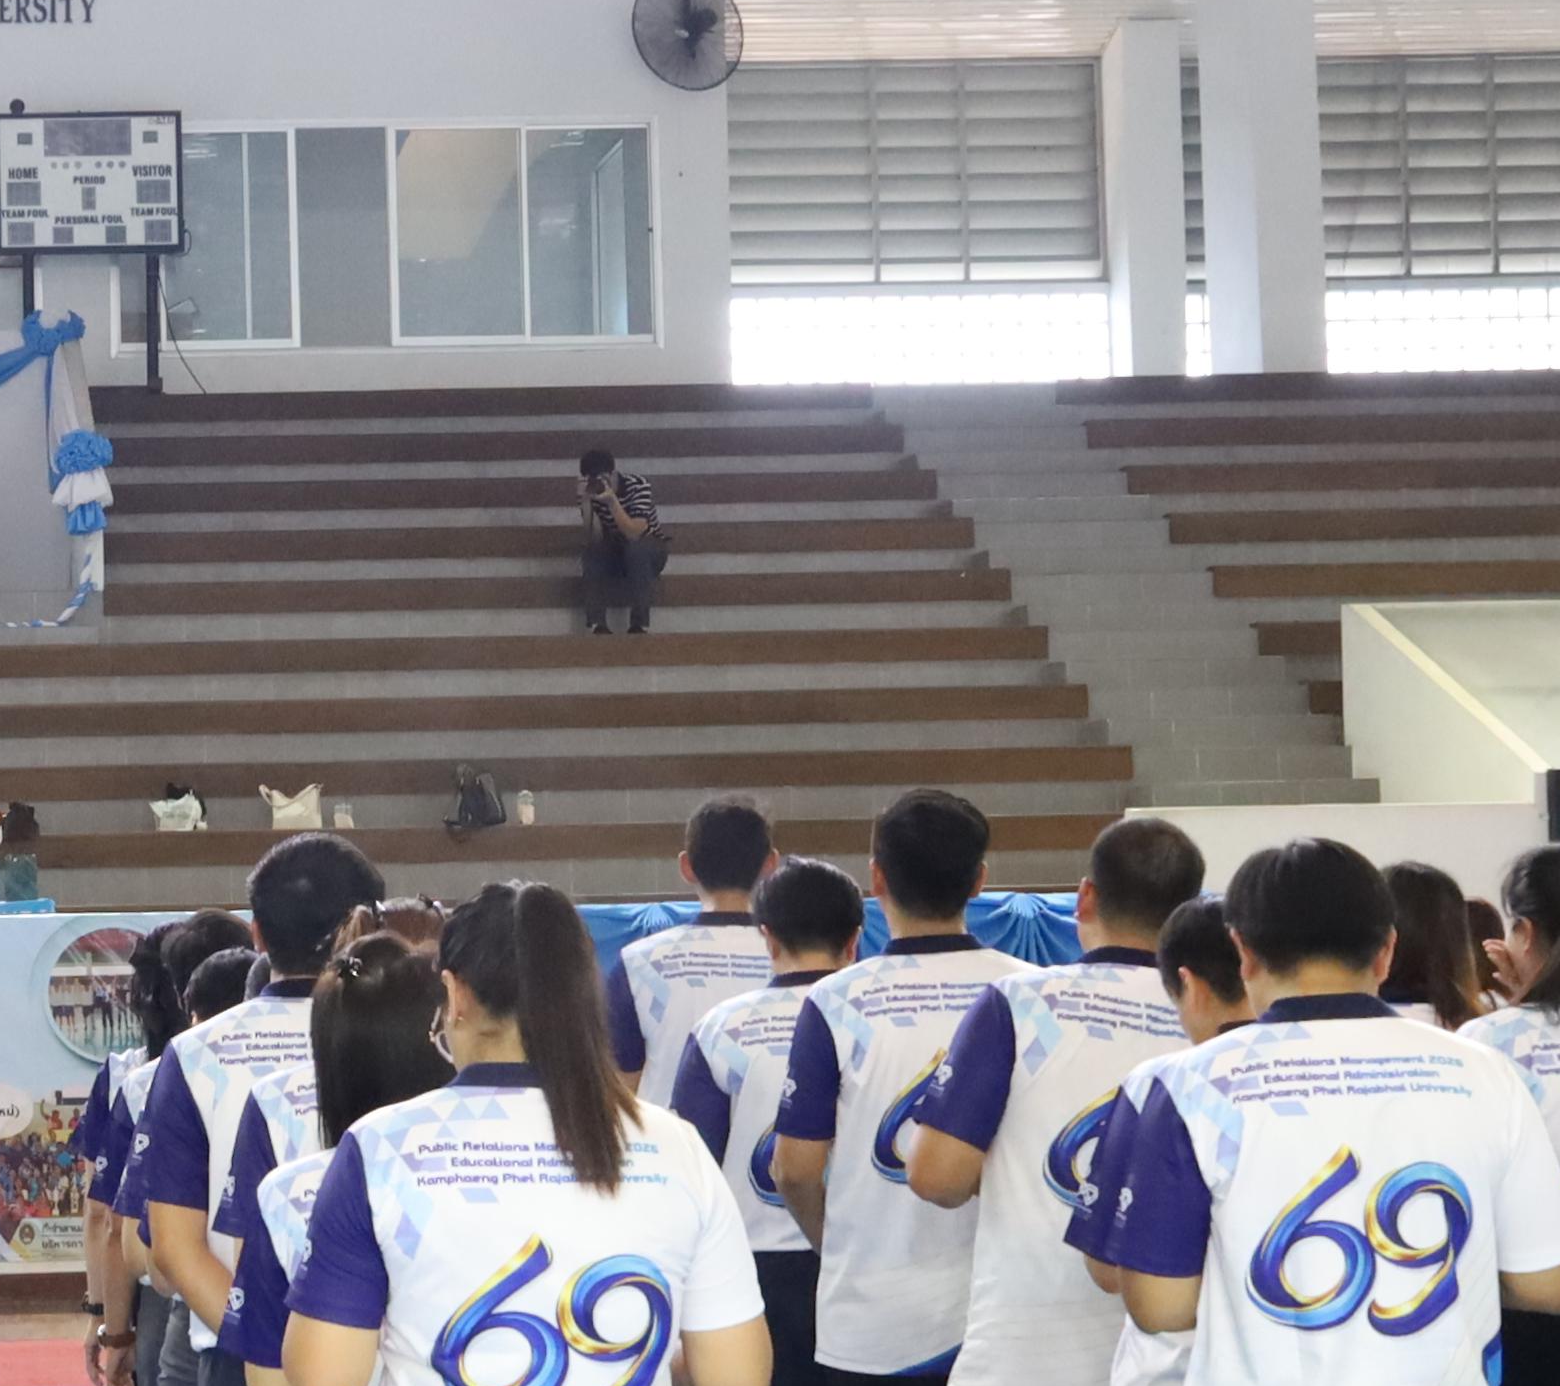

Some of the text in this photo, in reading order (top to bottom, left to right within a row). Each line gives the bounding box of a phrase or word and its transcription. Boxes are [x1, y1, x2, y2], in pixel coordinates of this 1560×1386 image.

[8, 168, 38, 179] HOME
[132, 165, 172, 177] VISITOR
[73, 176, 105, 184] PERIOD
[1, 209, 49, 218] TEAM FOUL
[130, 208, 154, 216] TEAM
[54, 215, 123, 224] PERSONAL FOUL
[1231, 1062, 1270, 1076] Public
[1273, 1058, 1336, 1069] Relations
[1340, 1055, 1424, 1066] Management
[1263, 1069, 1440, 1084] Educational Administration
[1232, 1083, 1472, 1103] Kamphaeng Phet Rajabhat University
[418, 1142, 458, 1154] Public
[463, 1141, 529, 1152] Relations
[451, 1157, 532, 1168] Educational
[417, 1173, 498, 1187] Kamphaeng
[502, 1173, 534, 1183] Phet
[1245, 1144, 1473, 1336] 69
